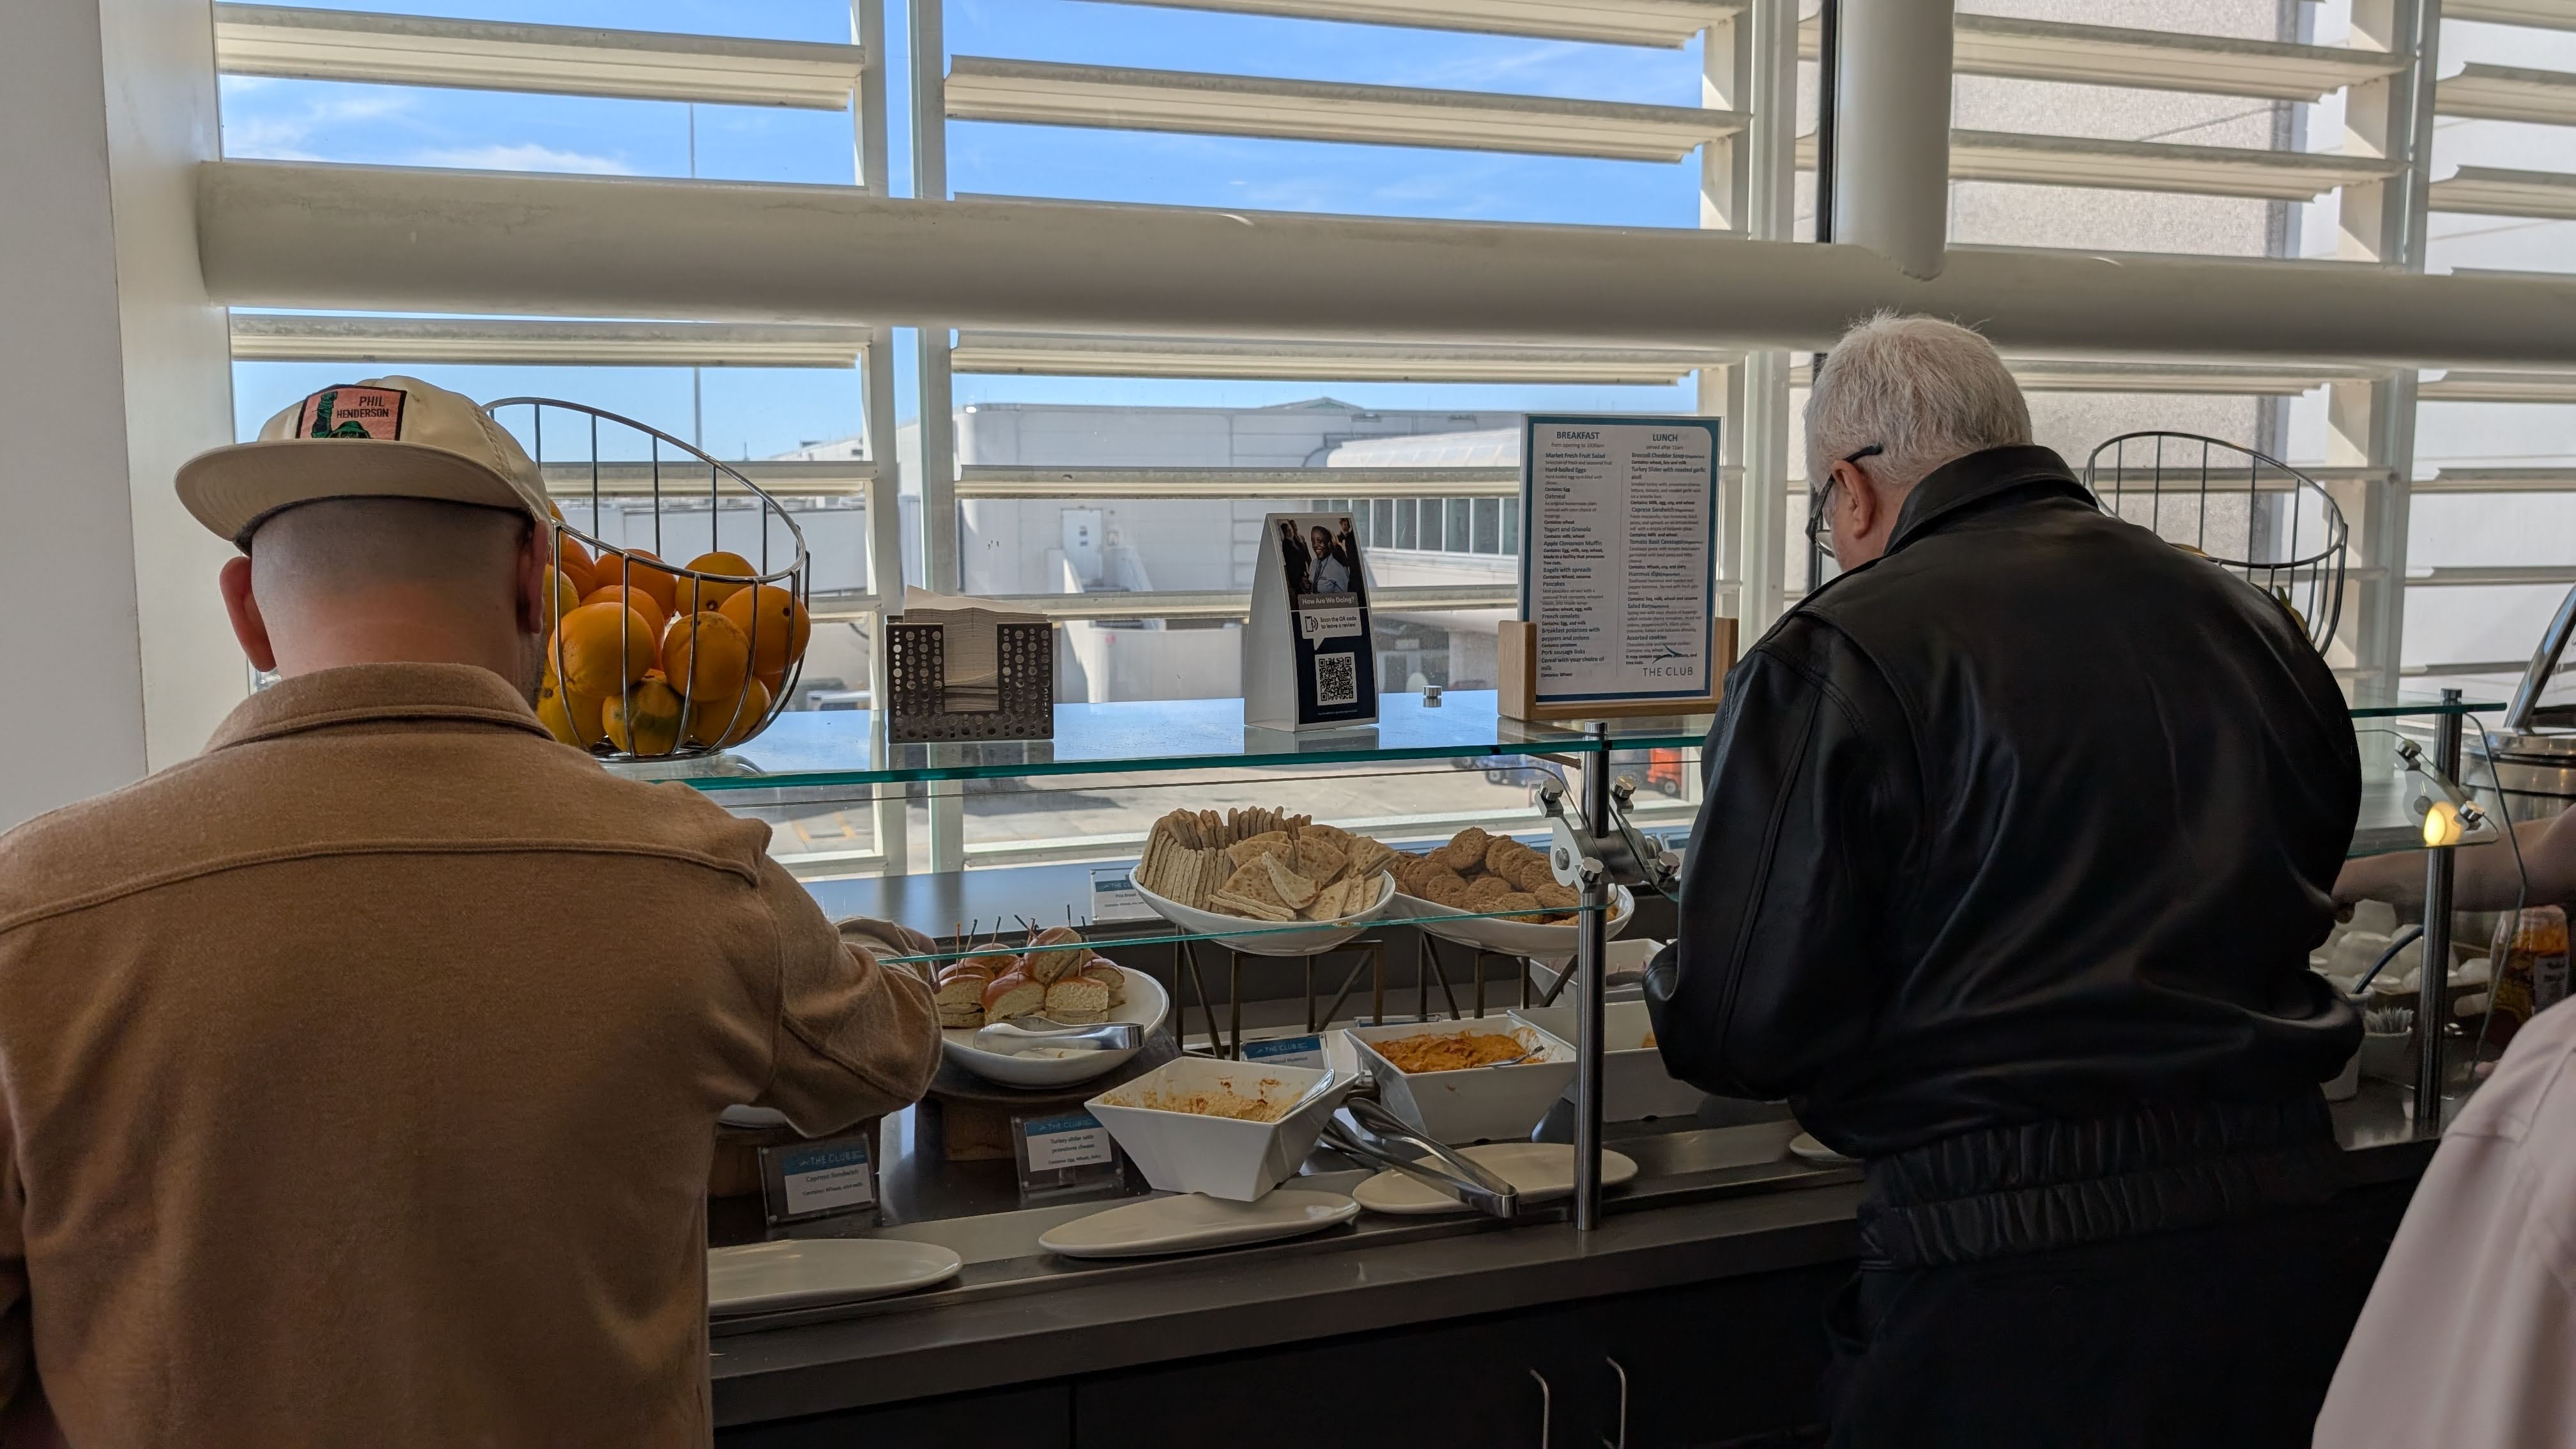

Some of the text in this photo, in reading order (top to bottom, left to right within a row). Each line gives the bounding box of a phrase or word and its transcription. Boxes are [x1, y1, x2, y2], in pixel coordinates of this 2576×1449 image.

[359, 396, 385, 406] PHIL
[337, 408, 388, 418] HENDERSON
[1643, 667, 1692, 677] THE CLUB
[829, 1152, 851, 1162] CLUB
